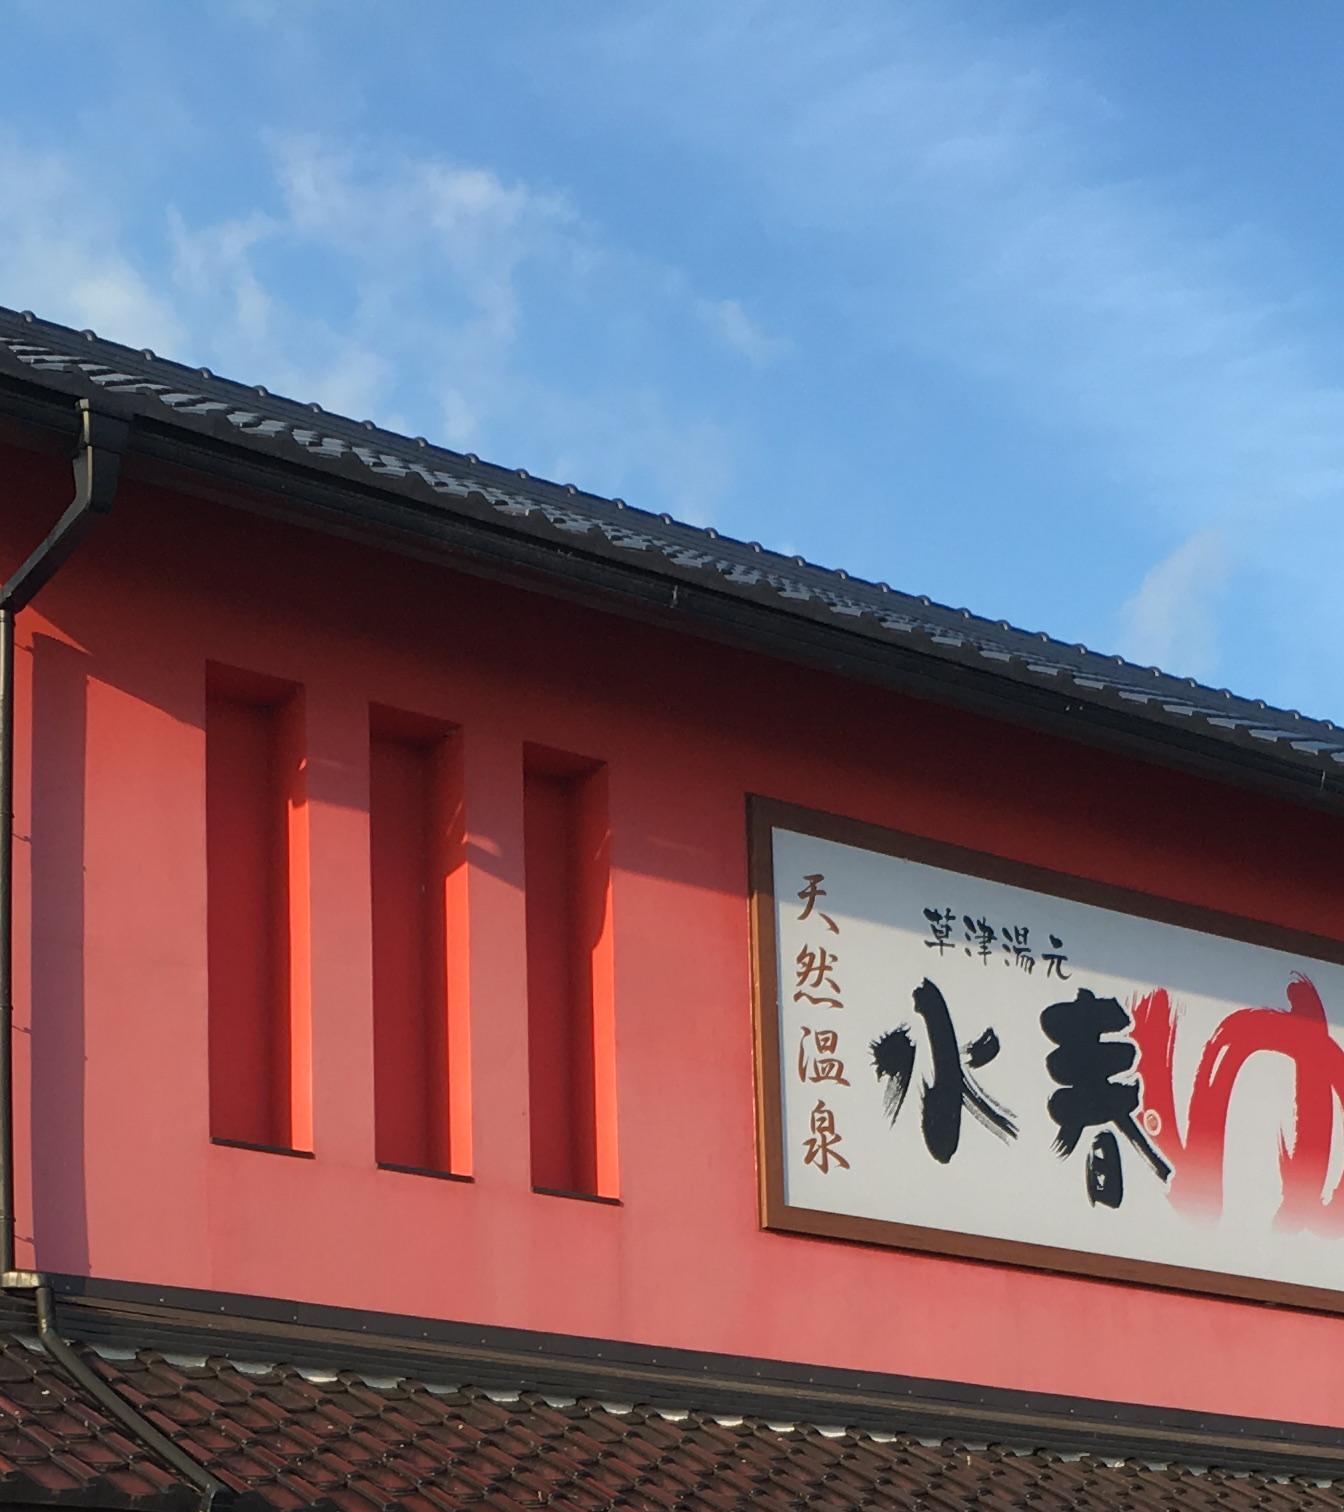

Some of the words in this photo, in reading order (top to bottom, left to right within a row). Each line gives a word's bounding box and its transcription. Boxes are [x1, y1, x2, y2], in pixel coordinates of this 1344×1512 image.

[793, 873, 851, 1175] 天然温泉
[922, 908, 1072, 980] 草津湯元
[869, 977, 1173, 1209] 水春
